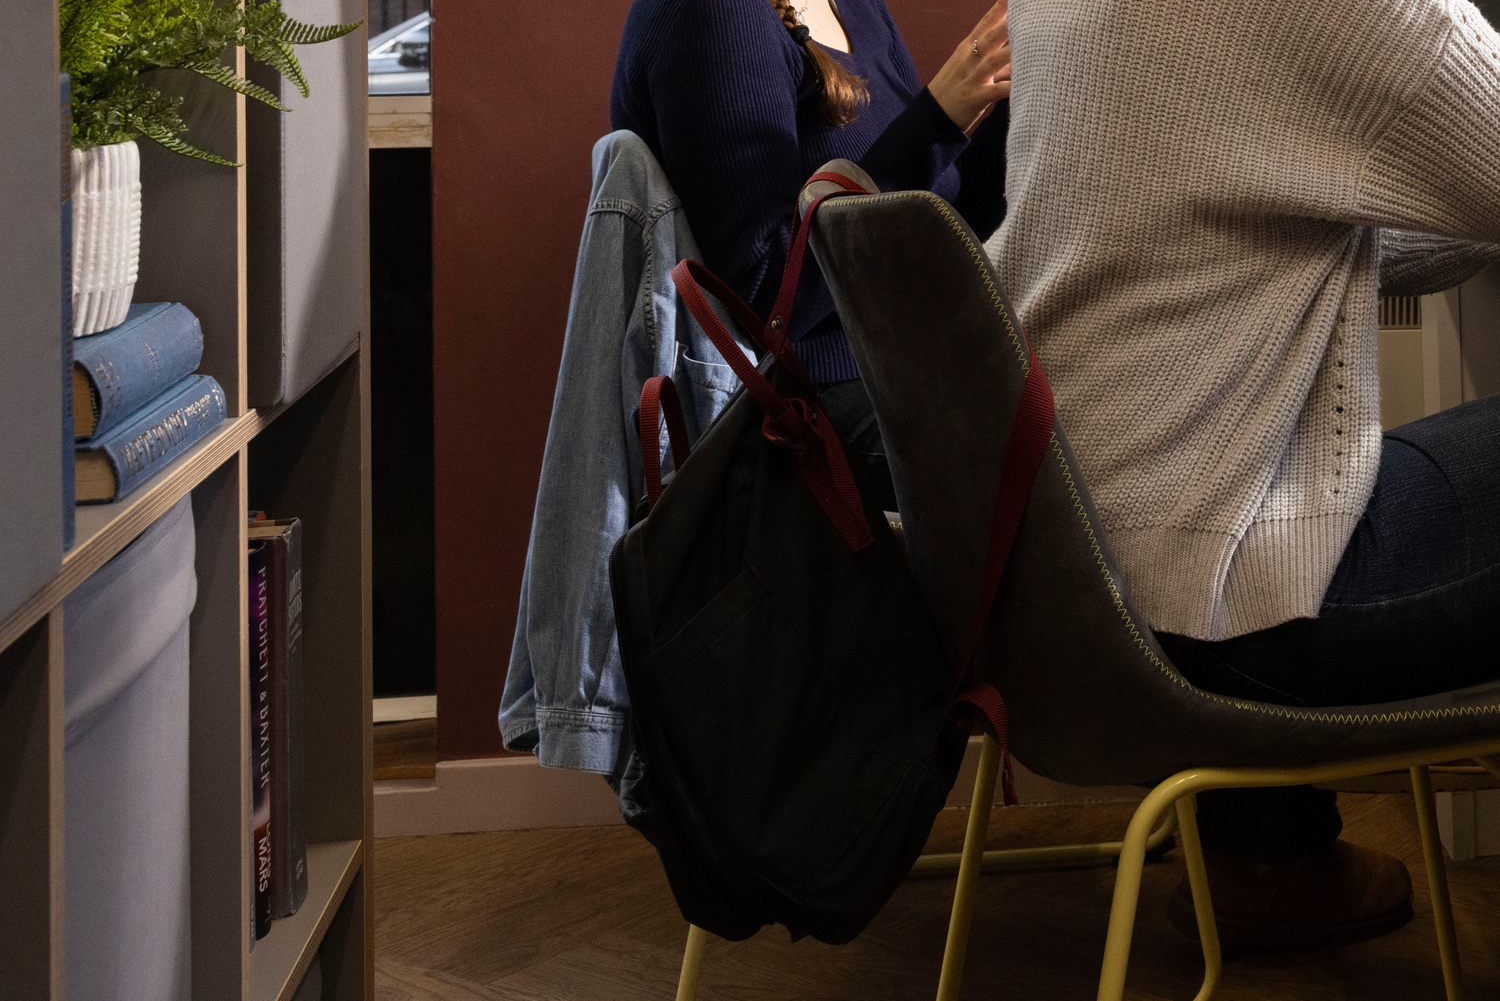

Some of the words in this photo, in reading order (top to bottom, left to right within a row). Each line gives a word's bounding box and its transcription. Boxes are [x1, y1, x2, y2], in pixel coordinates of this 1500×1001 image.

[258, 566, 268, 683] PRATCHETT
[258, 691, 267, 702] &
[260, 705, 270, 788] BAXTER
[259, 837, 268, 893] MARS
